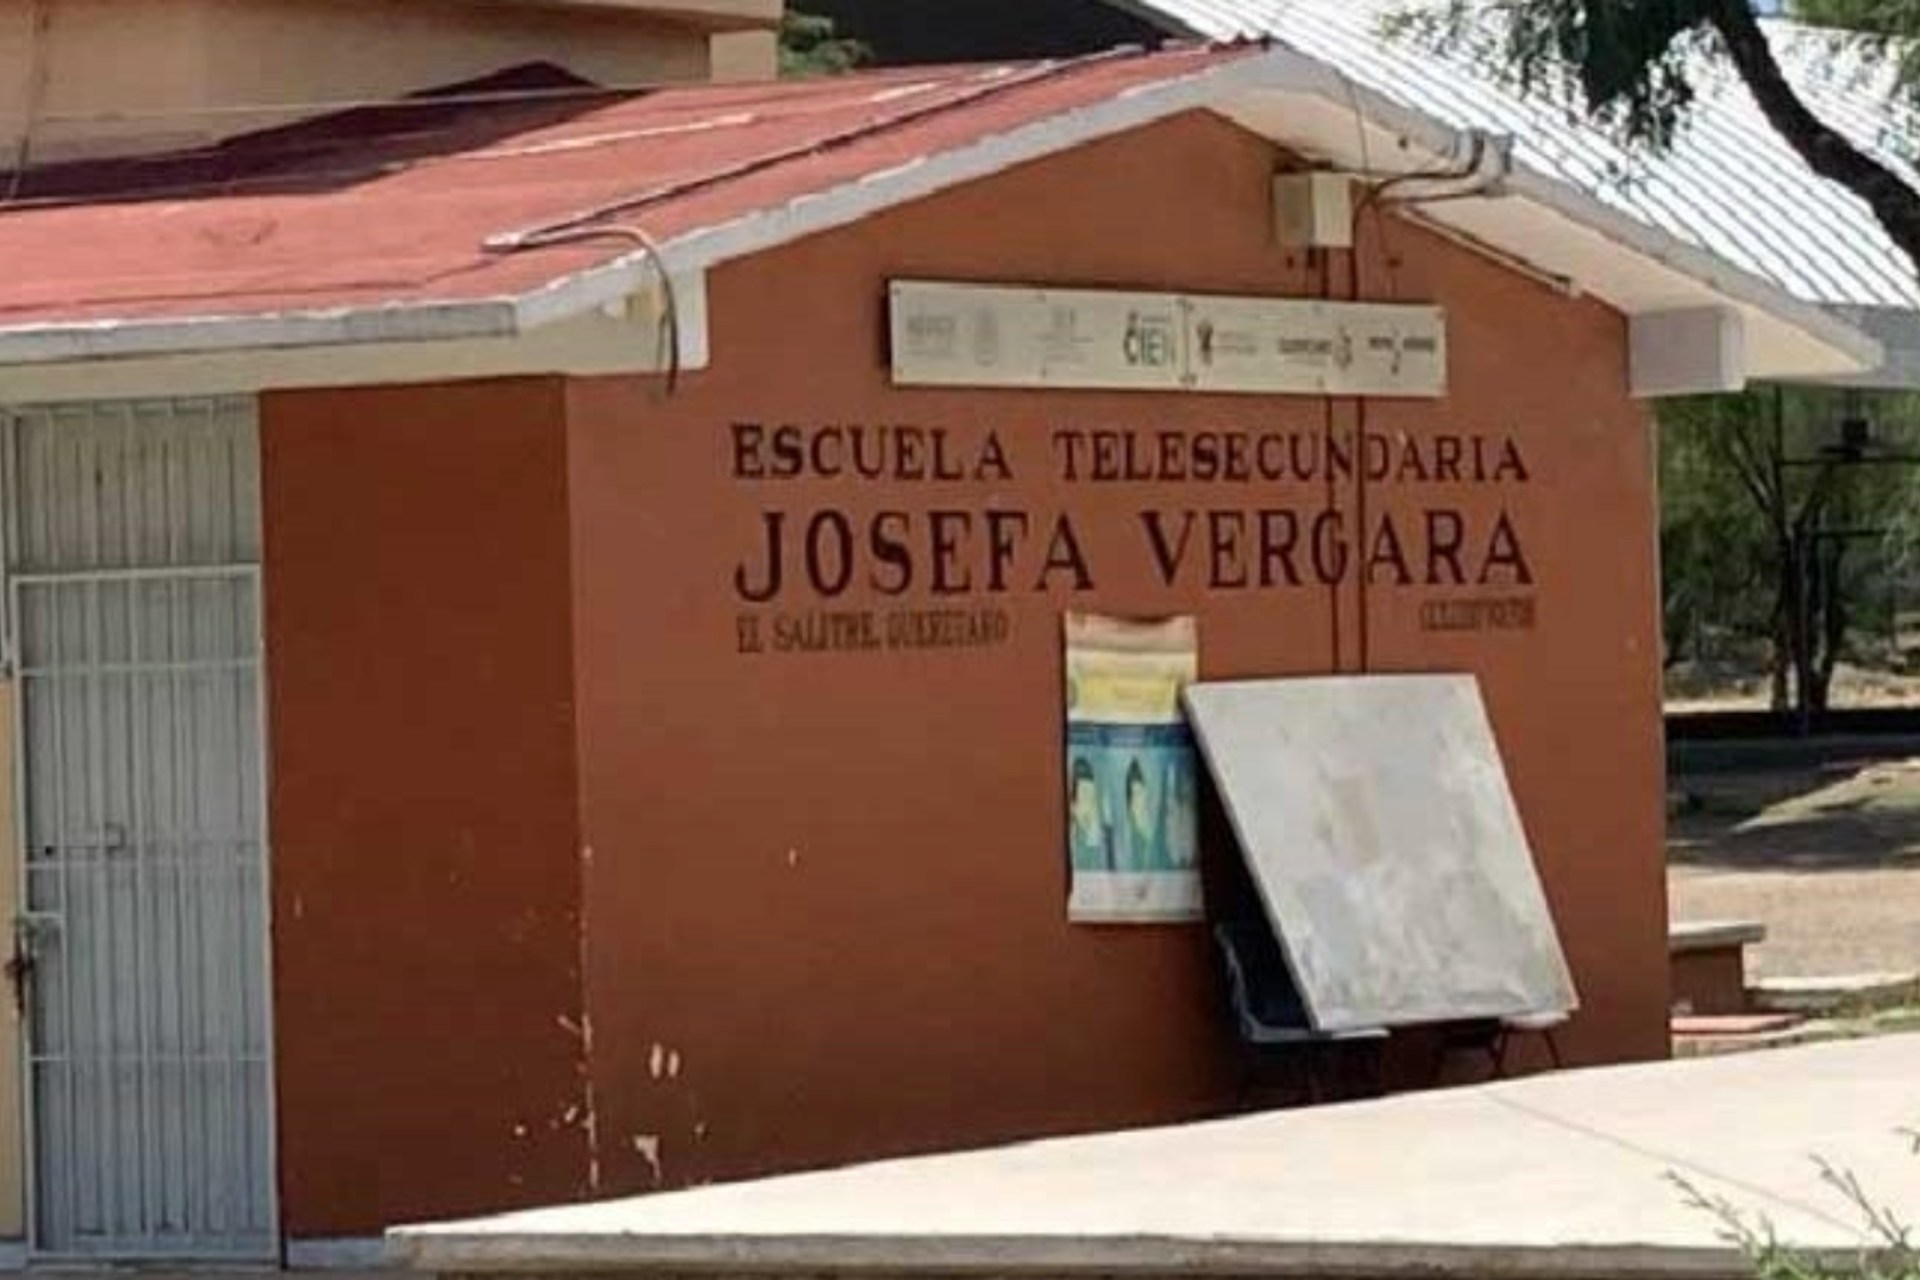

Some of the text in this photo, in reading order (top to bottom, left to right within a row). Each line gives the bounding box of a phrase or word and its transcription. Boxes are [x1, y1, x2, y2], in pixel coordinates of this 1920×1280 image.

[732, 424, 1529, 483] ESCUELA TELESECUNDARIA
[735, 508, 1534, 602] JOSEFA VERGARA
